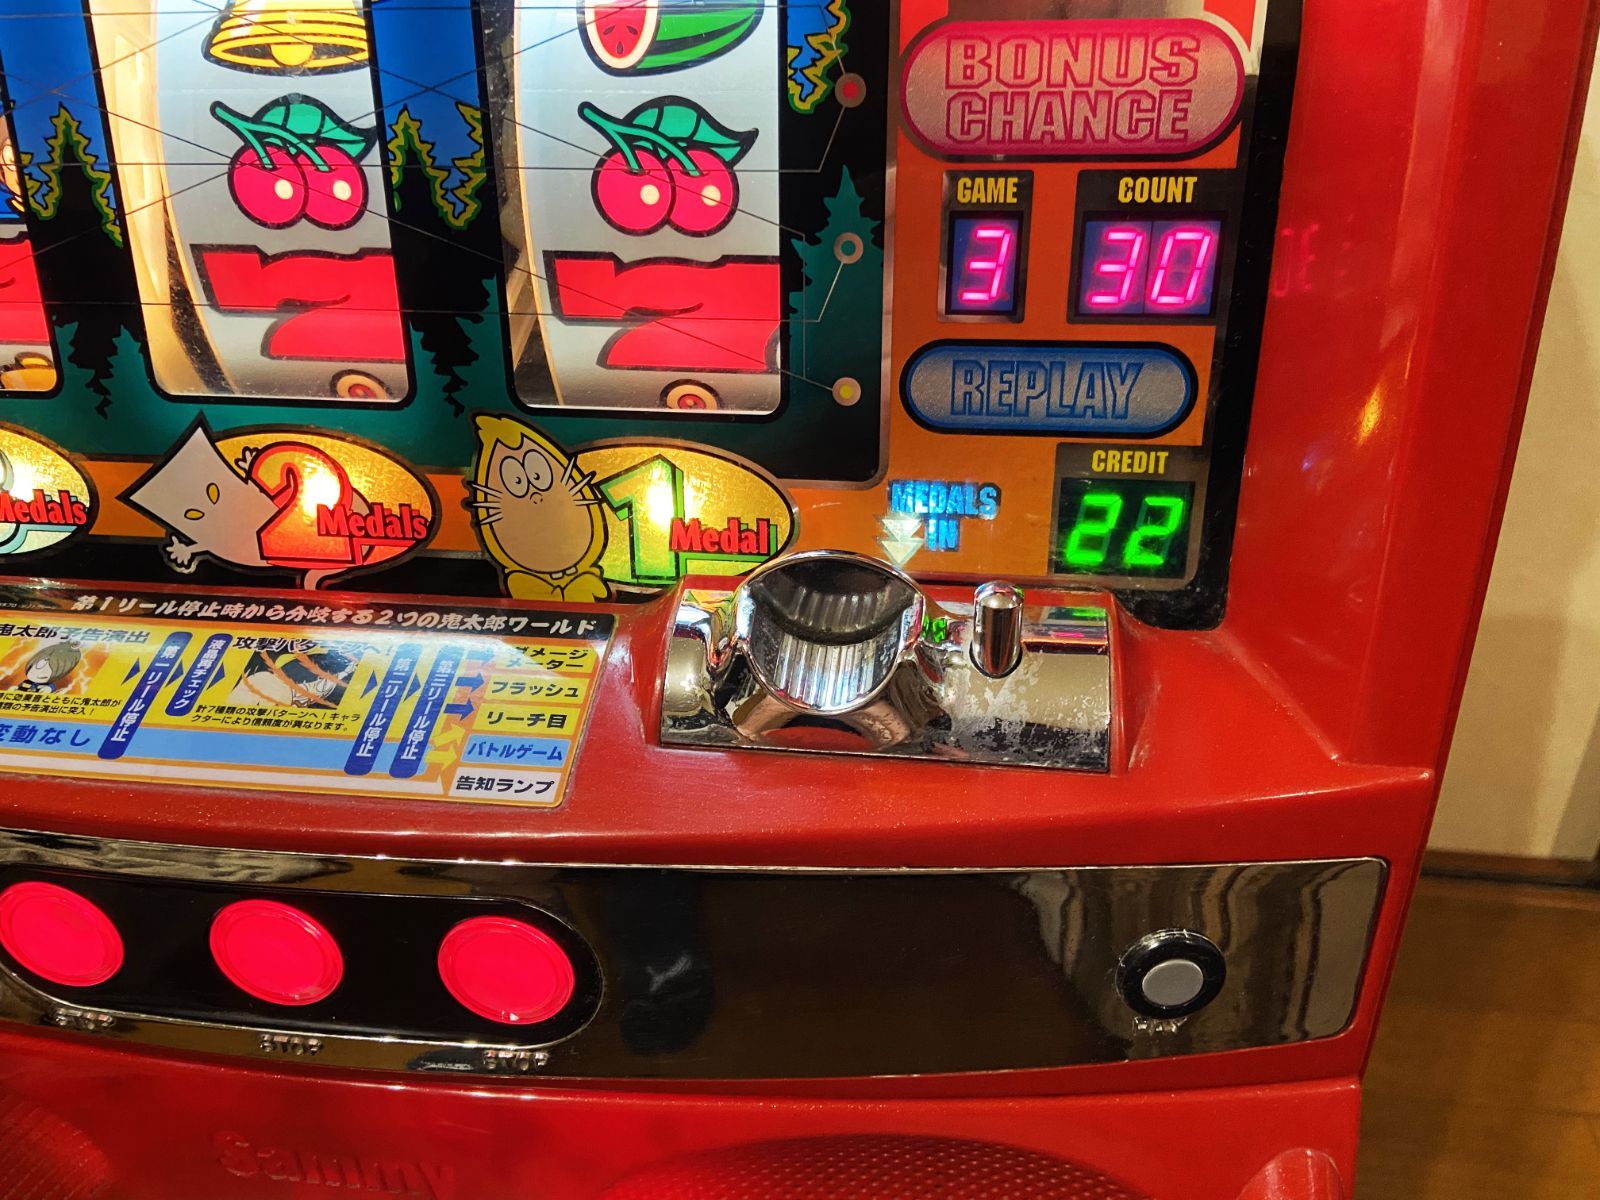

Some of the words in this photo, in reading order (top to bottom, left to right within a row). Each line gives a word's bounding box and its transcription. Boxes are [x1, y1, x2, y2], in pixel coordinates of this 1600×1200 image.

[945, 32, 1201, 89] BONUS
[945, 89, 1193, 145] CHANCE
[956, 177, 1019, 204] GAME
[1117, 176, 1198, 204] COUNT
[959, 228, 1012, 304] 3
[1088, 230, 1212, 306] 30
[951, 359, 1144, 420] REPLAY
[1091, 450, 1169, 475] CREDIT
[252, 440, 354, 565] 2
[317, 502, 430, 543] Medals
[600, 454, 685, 583] 1
[669, 517, 771, 555] Medal
[888, 480, 1002, 520] MEDALS
[925, 517, 960, 552] IN
[1062, 493, 1185, 567] 22
[110, 645, 181, 742] 第一リール停止
[355, 657, 412, 757] 第二リール停止
[400, 660, 454, 760] 第三リール停止
[491, 681, 579, 698] フラッシュ
[487, 711, 568, 729] リーチ目
[467, 741, 563, 761] バトルゲーム
[455, 775, 556, 795] 告知ランプ
